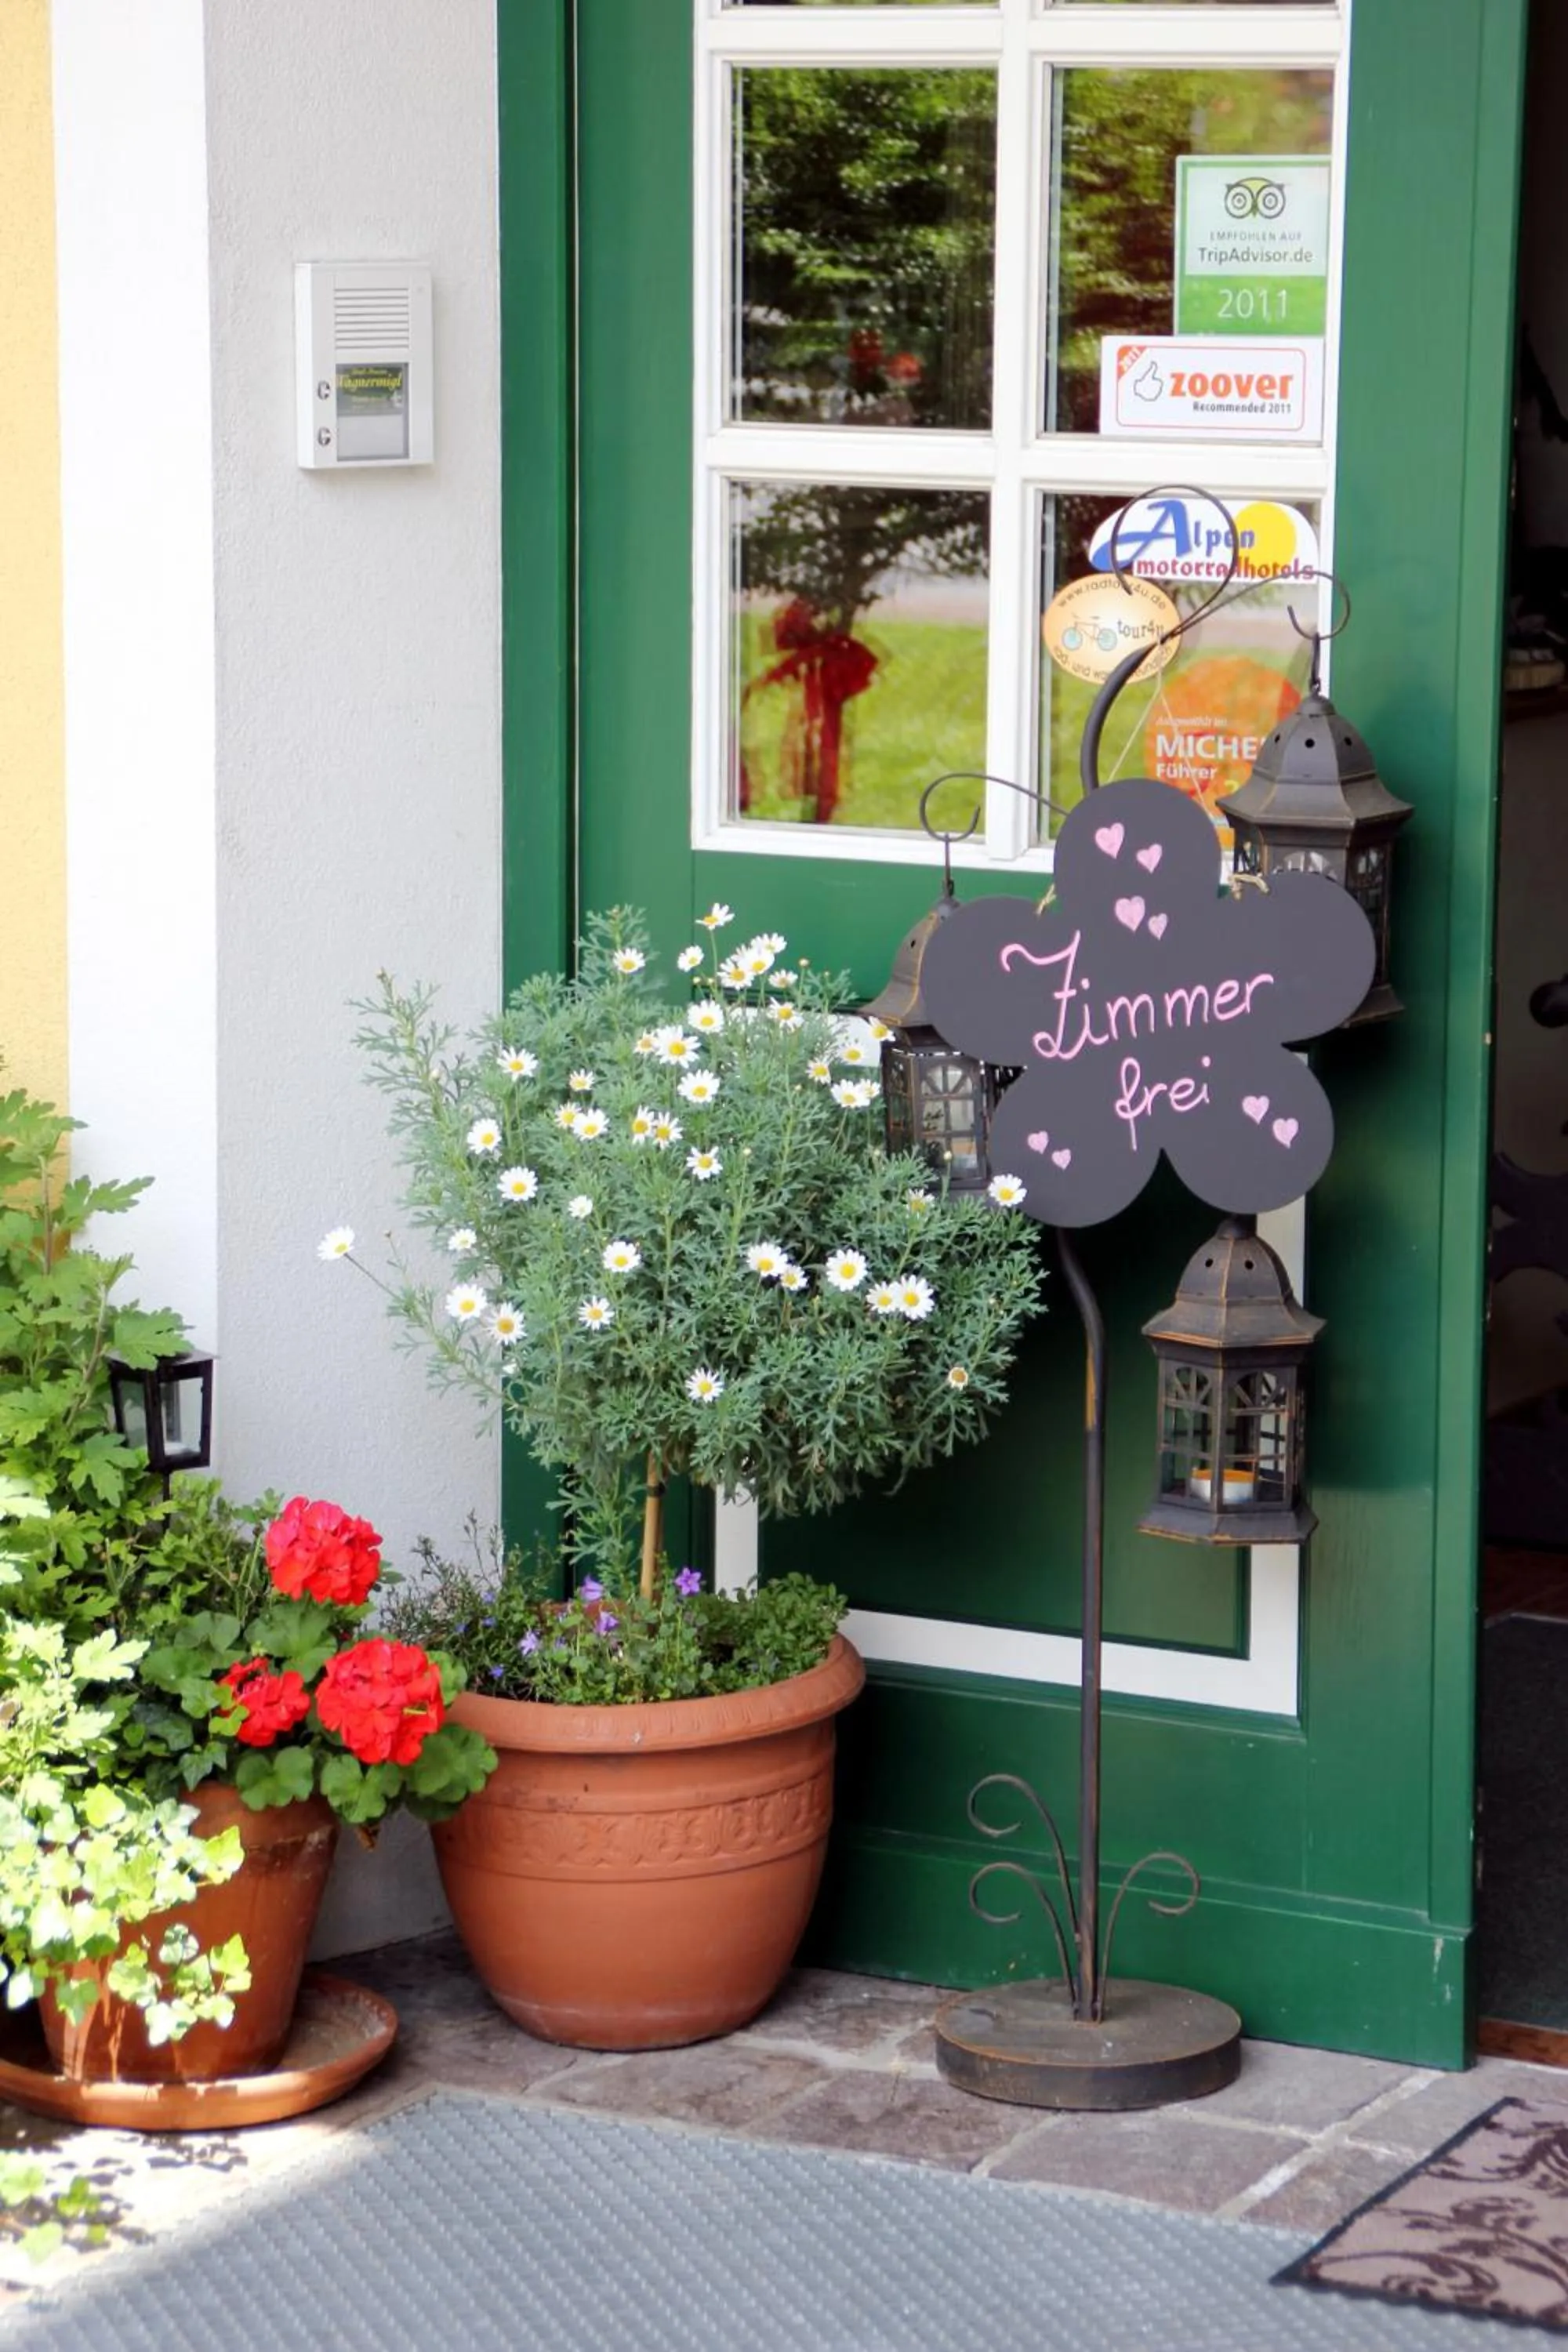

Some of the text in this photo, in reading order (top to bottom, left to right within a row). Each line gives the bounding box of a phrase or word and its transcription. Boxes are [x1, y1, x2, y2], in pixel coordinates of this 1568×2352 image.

[1209, 230, 1302, 241] EMPFOHLEN AUF
[1198, 246, 1313, 265] TripAdvisor.de
[1217, 288, 1287, 320] 2011
[1170, 372, 1294, 400] zoover
[1192, 401, 1291, 414] Recommended 2011
[1091, 499, 1255, 572] Alpen
[1058, 578, 1166, 610] www.radto4u.de
[1156, 733, 1266, 760] MICHE
[1156, 761, 1218, 779] Führer
[1000, 929, 1274, 1060] Zimmer
[1114, 1055, 1211, 1151] frei
